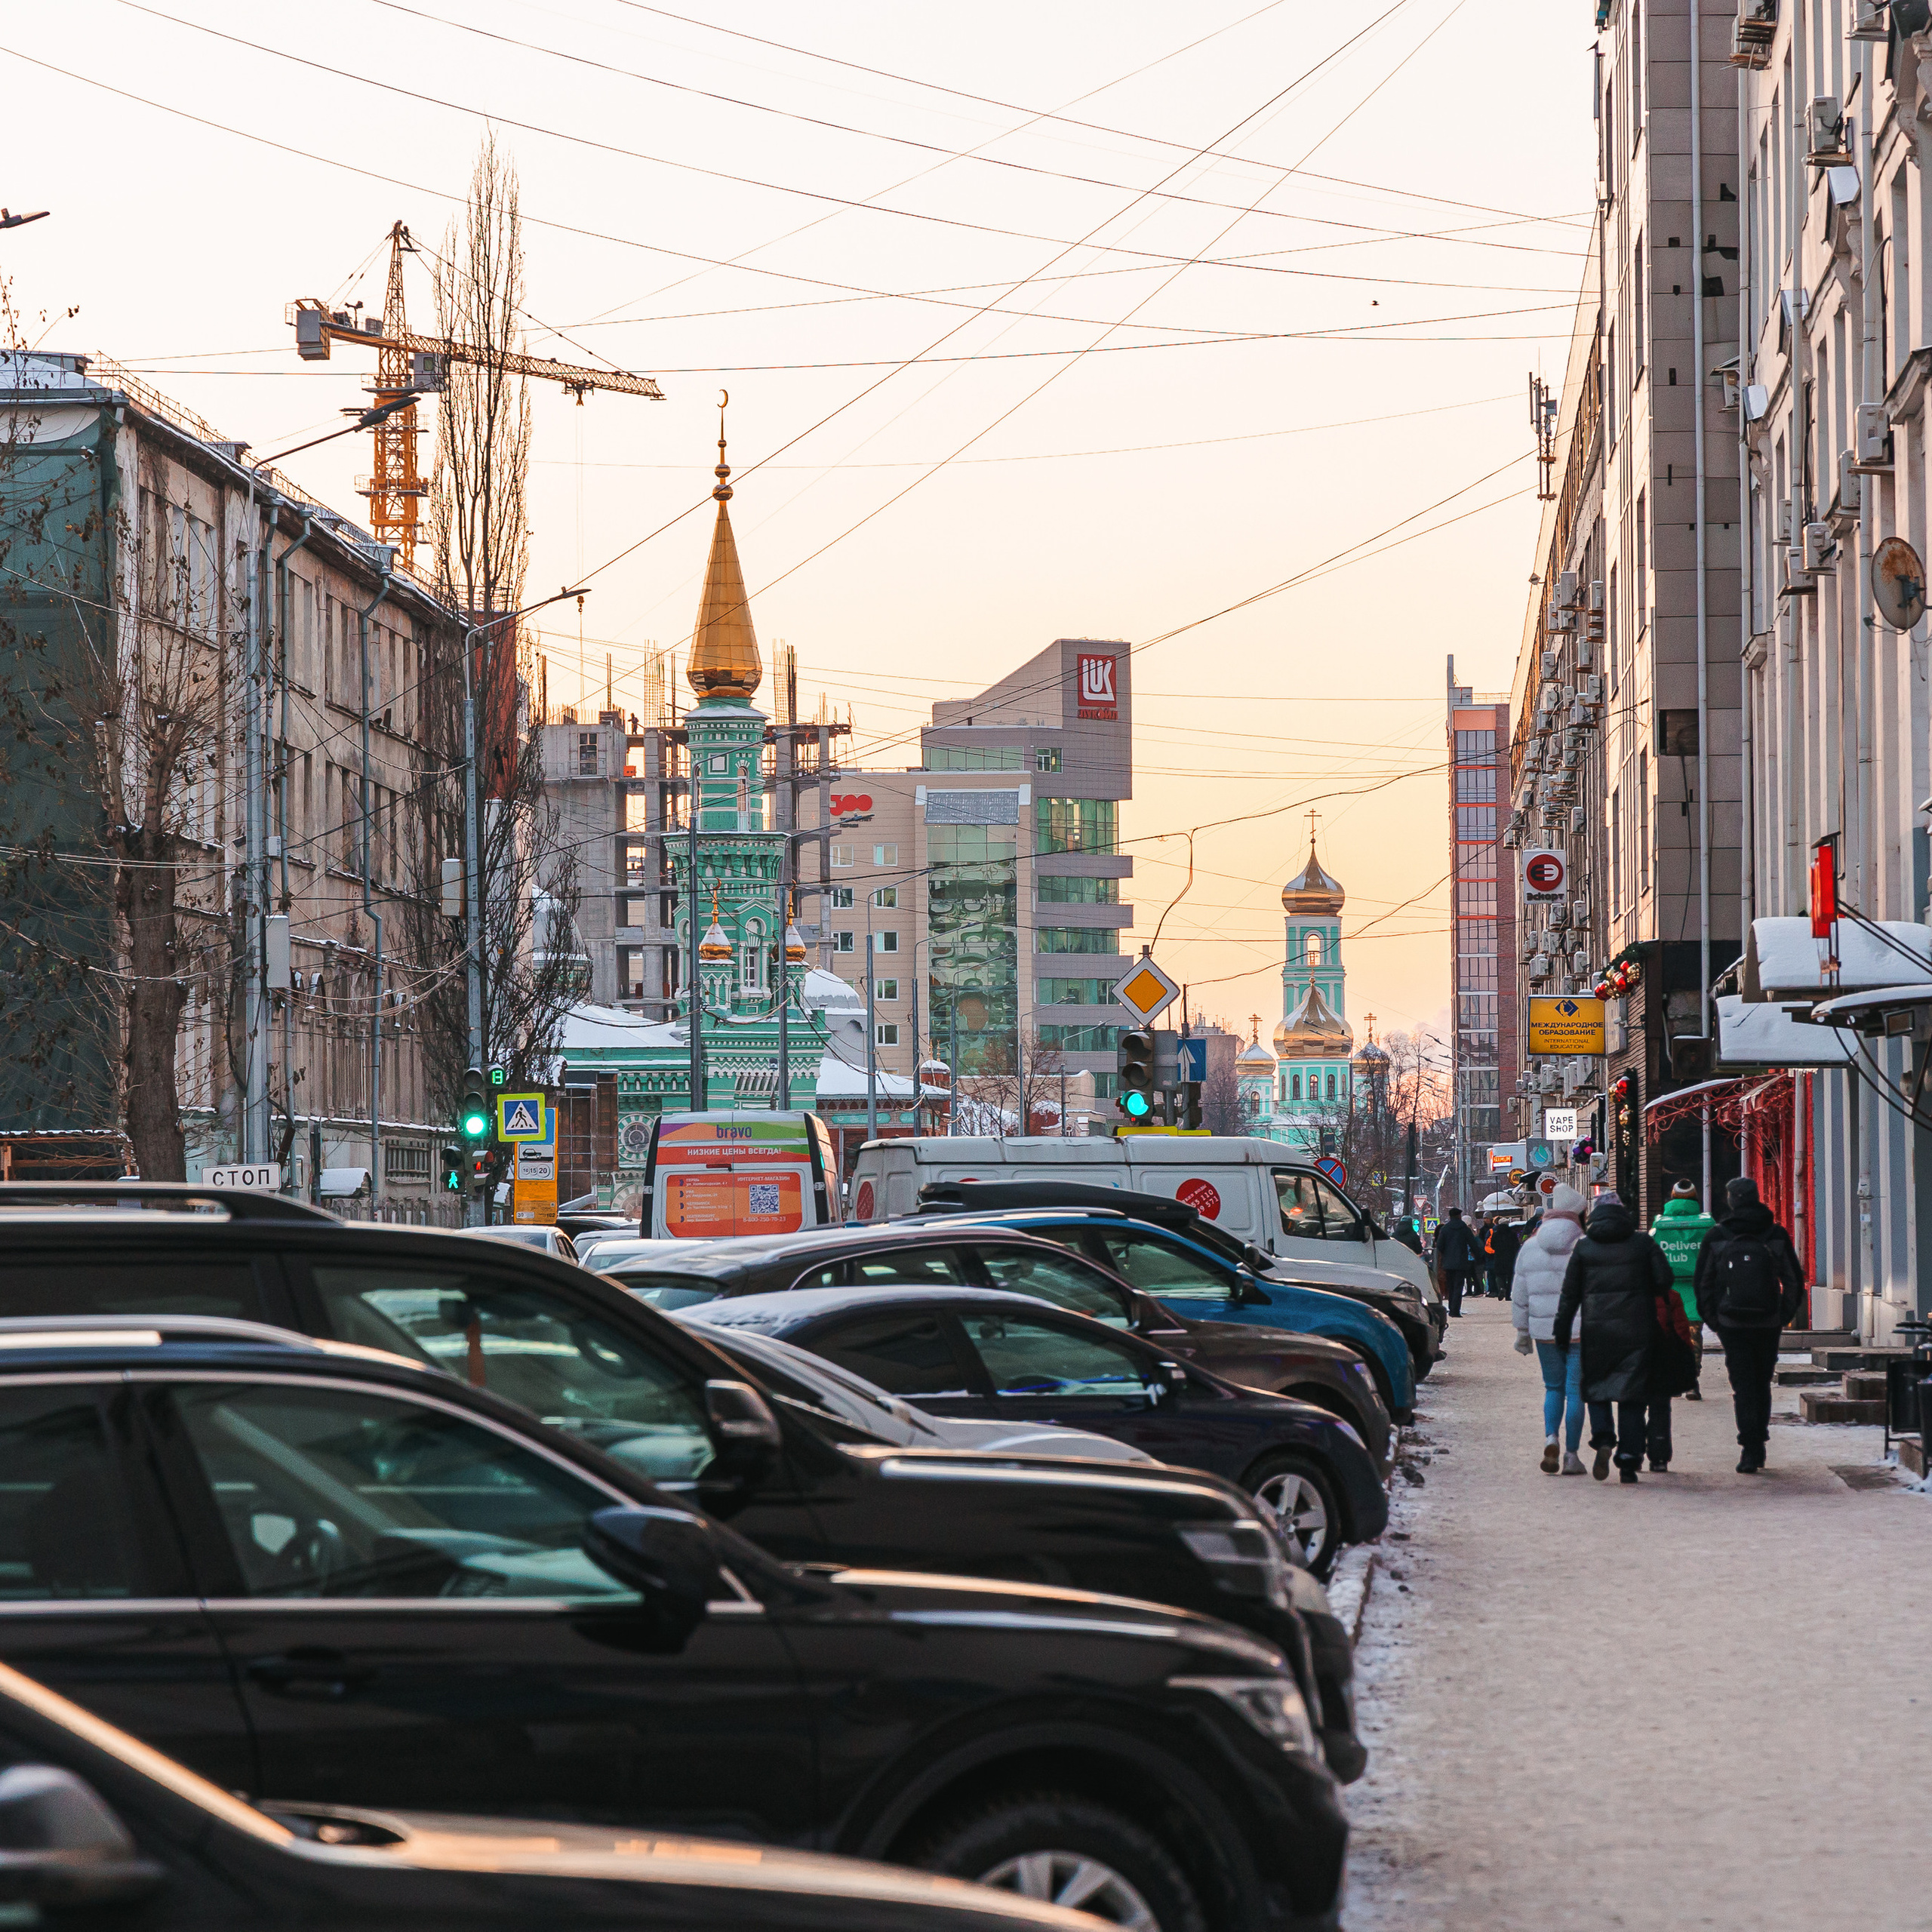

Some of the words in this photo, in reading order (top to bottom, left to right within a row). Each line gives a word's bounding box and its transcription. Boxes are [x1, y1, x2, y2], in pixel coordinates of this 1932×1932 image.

[1078, 708, 1118, 720] ЛУКОЙЛ
[492, 1070, 503, 1084] 13
[716, 1124, 752, 1139] bravo
[1549, 1124, 1574, 1133] SHOP
[722, 1148, 746, 1156] ЦЕНЫ
[212, 1169, 269, 1186] СТОП
[1200, 1189, 1214, 1201] 110
[1205, 1195, 1219, 1208] 571
[1660, 1241, 1702, 1251] Deliver
[1665, 1253, 1688, 1263] lub
